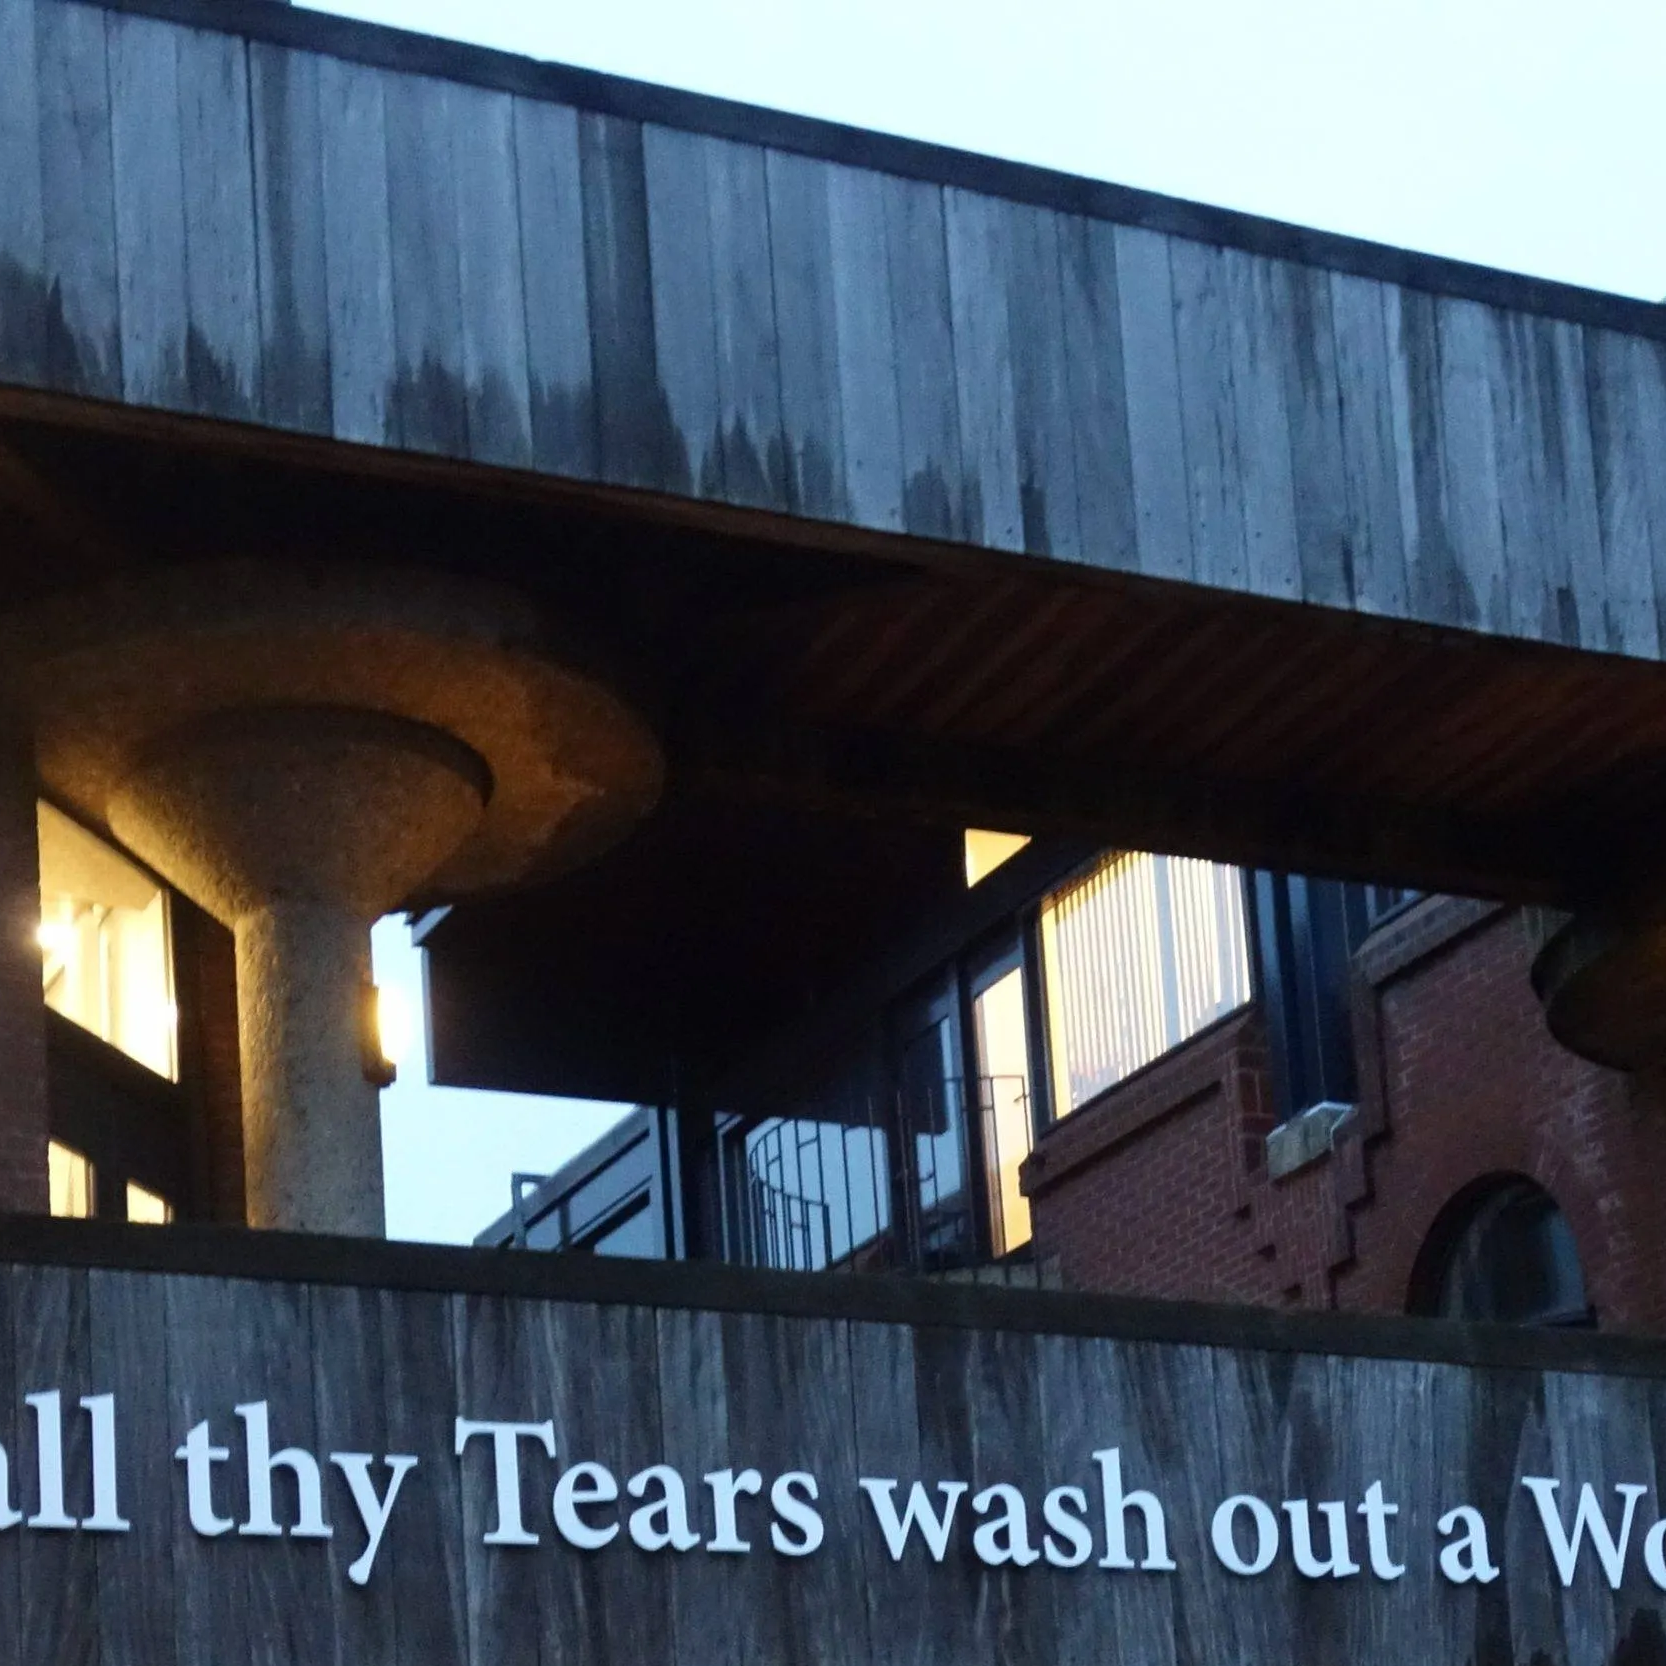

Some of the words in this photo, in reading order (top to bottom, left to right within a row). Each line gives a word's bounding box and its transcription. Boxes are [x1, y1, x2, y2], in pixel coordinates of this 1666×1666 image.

[174, 1400, 418, 1586] thy
[454, 1416, 824, 1557] Tears
[857, 1446, 1177, 1571] wash
[1210, 1480, 1406, 1580] out
[1437, 1505, 1500, 1583] a
